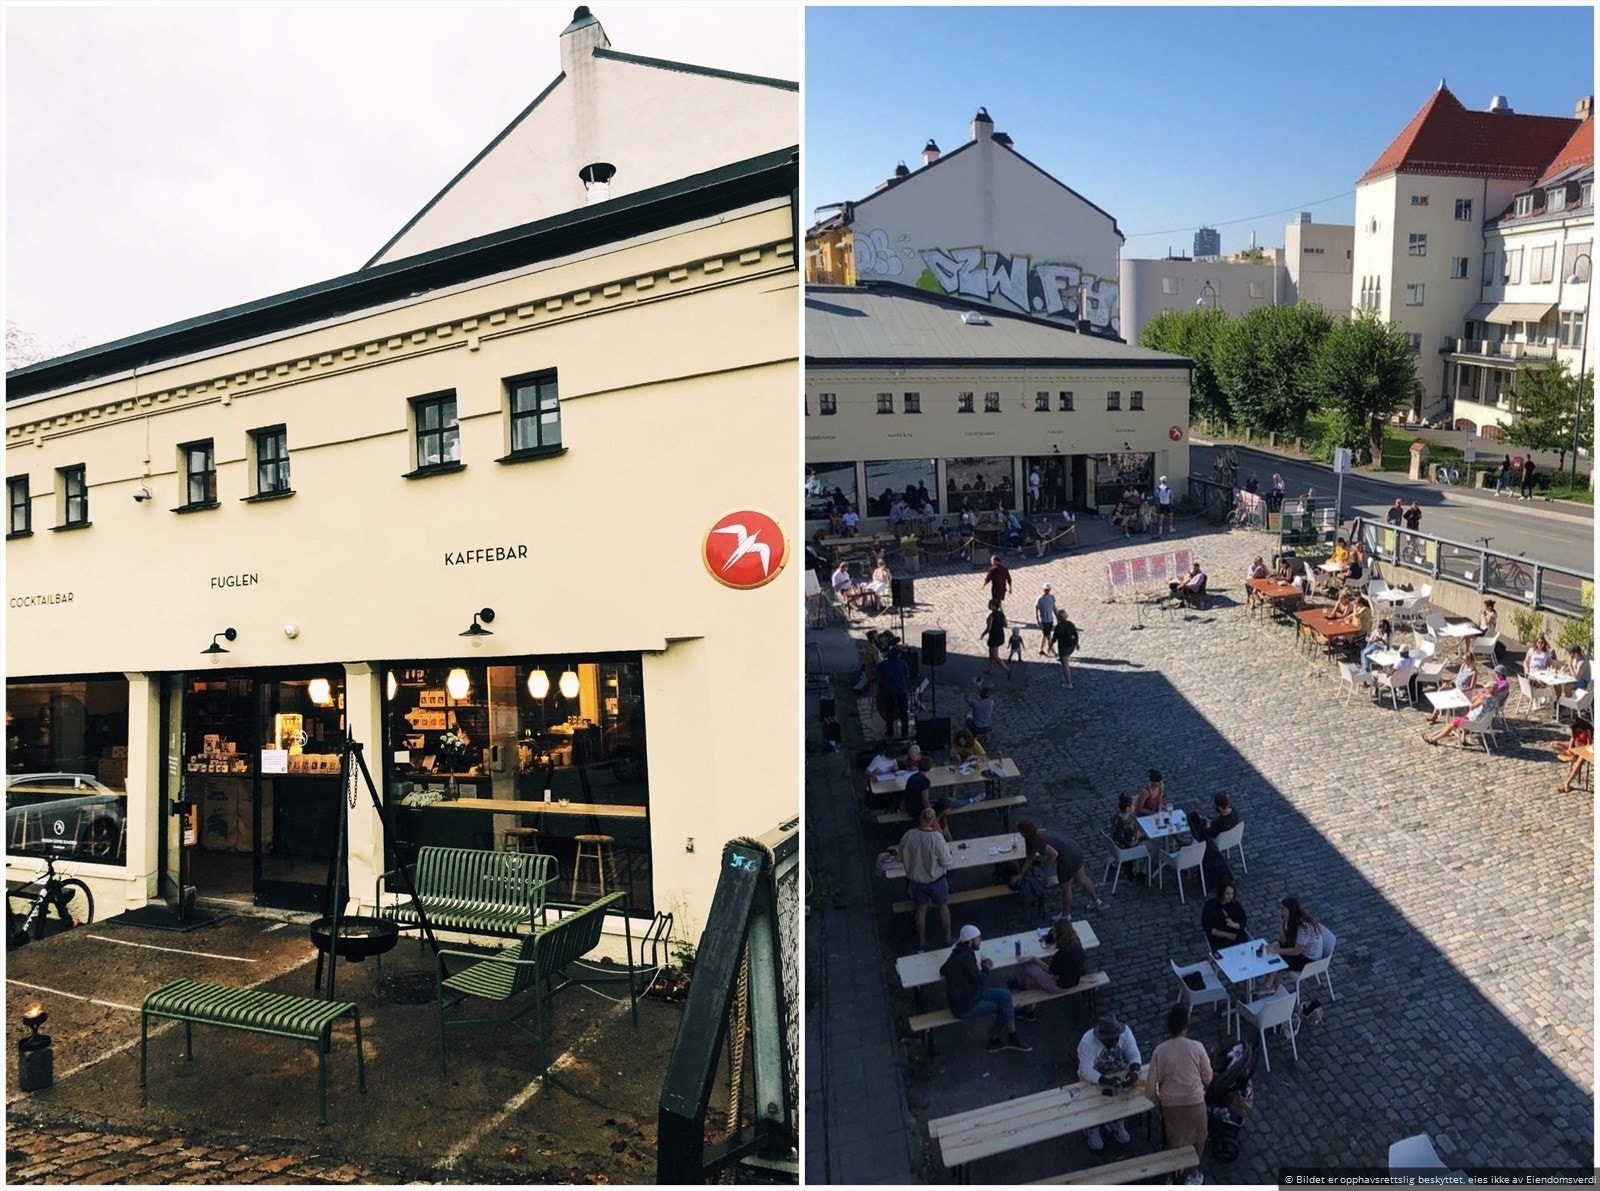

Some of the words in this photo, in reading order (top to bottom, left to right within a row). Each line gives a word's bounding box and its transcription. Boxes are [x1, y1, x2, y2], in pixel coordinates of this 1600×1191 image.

[444, 544, 528, 566] KAFFEBAR
[211, 573, 259, 589] FUGLEN
[9, 592, 74, 608] COCKTAILBAR
